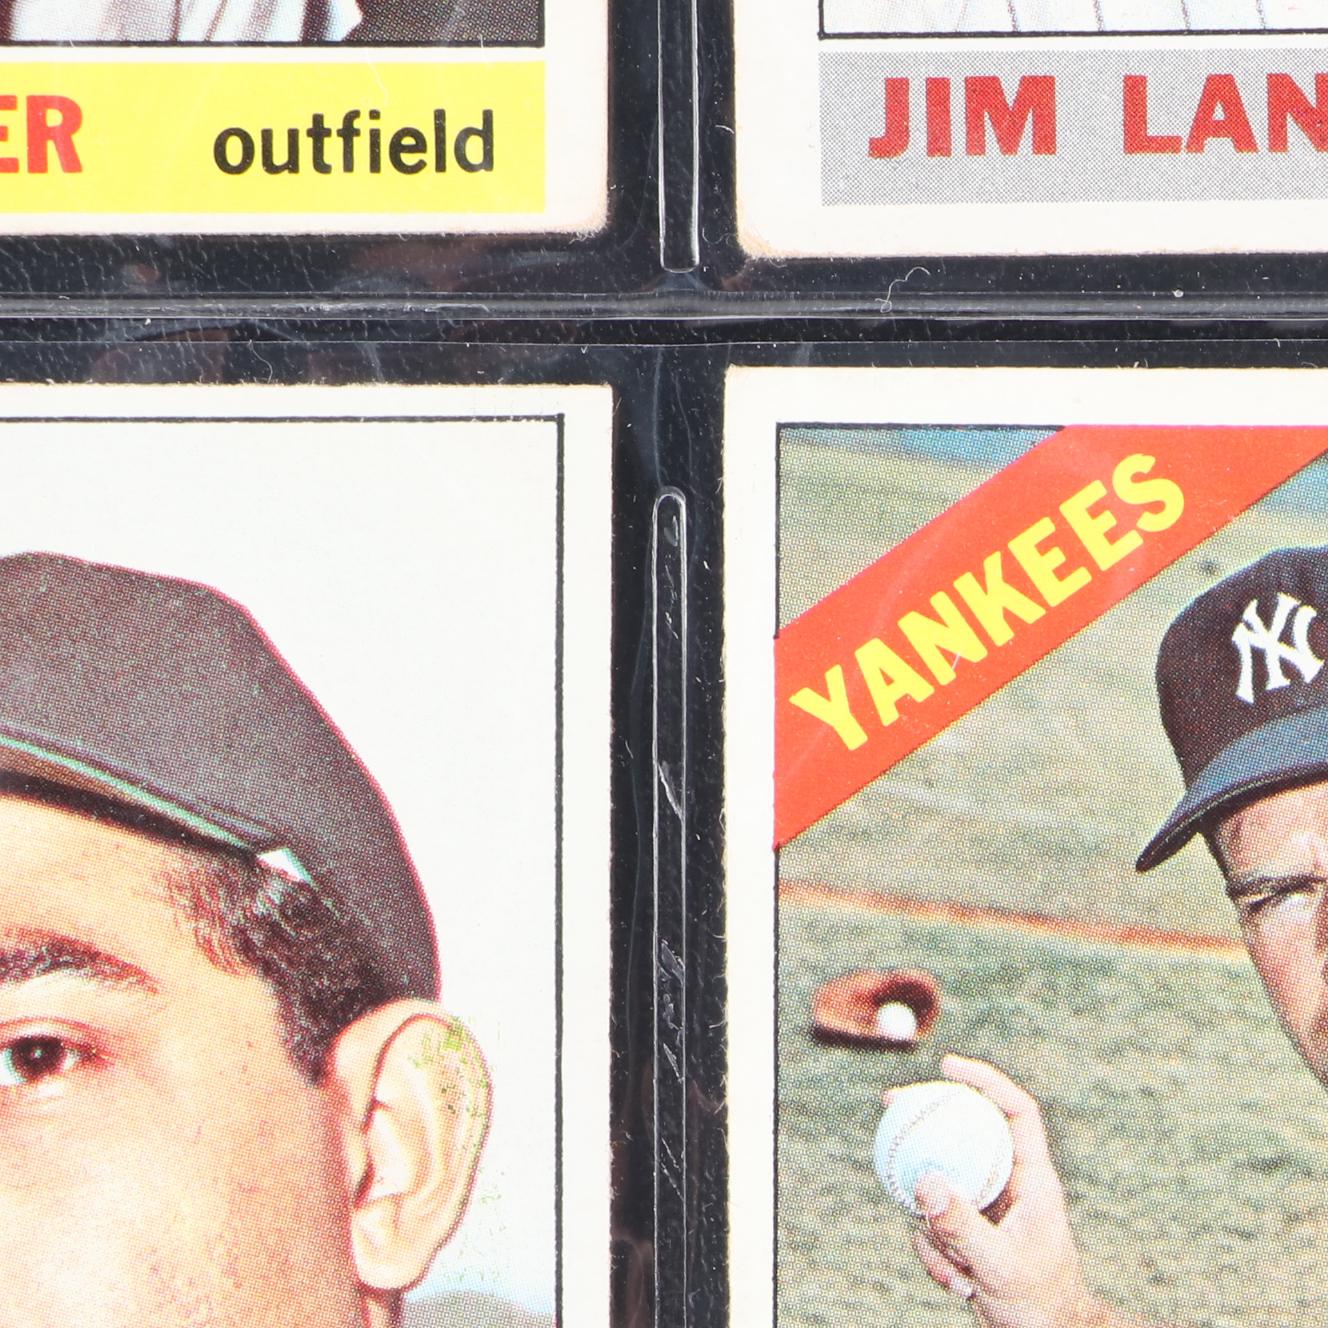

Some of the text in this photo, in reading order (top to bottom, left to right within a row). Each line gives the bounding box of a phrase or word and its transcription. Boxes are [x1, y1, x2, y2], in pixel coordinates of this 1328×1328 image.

[213, 108, 495, 175] outfield
[867, 75, 1058, 158] JIM
[788, 452, 1186, 752] YANKEES
[1230, 591, 1326, 704] NY
